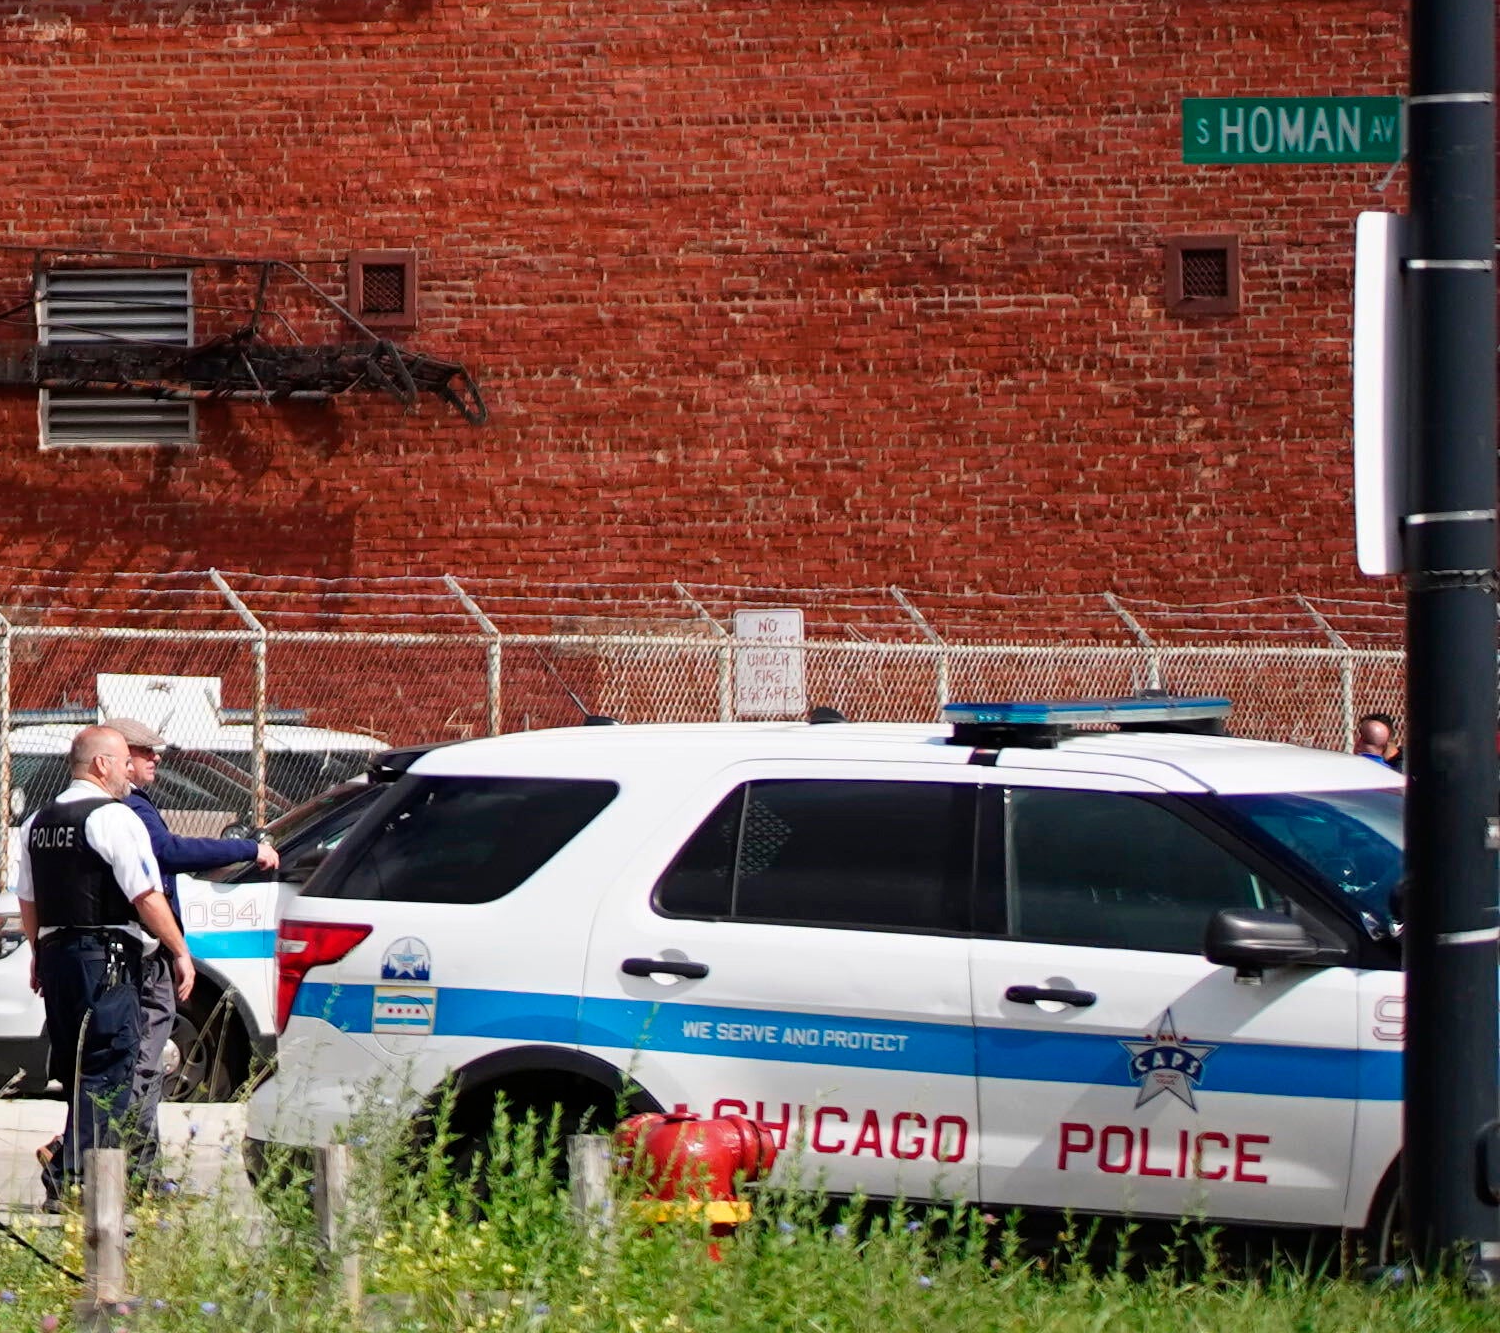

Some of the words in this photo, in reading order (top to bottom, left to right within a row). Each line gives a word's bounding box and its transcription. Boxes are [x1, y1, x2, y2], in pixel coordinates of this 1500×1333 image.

[1196, 118, 1210, 145] S
[1219, 106, 1361, 154] HOMAN
[1368, 115, 1396, 143] AV
[758, 617, 778, 633] NO
[31, 826, 75, 849] POLICE
[683, 1020, 714, 1040] WE
[716, 1022, 779, 1044] SERVE
[781, 1027, 819, 1046] AND
[823, 1029, 909, 1052] PROTECT
[1134, 1052, 1199, 1075] CAPS
[1059, 1121, 1271, 1184] POLICE
